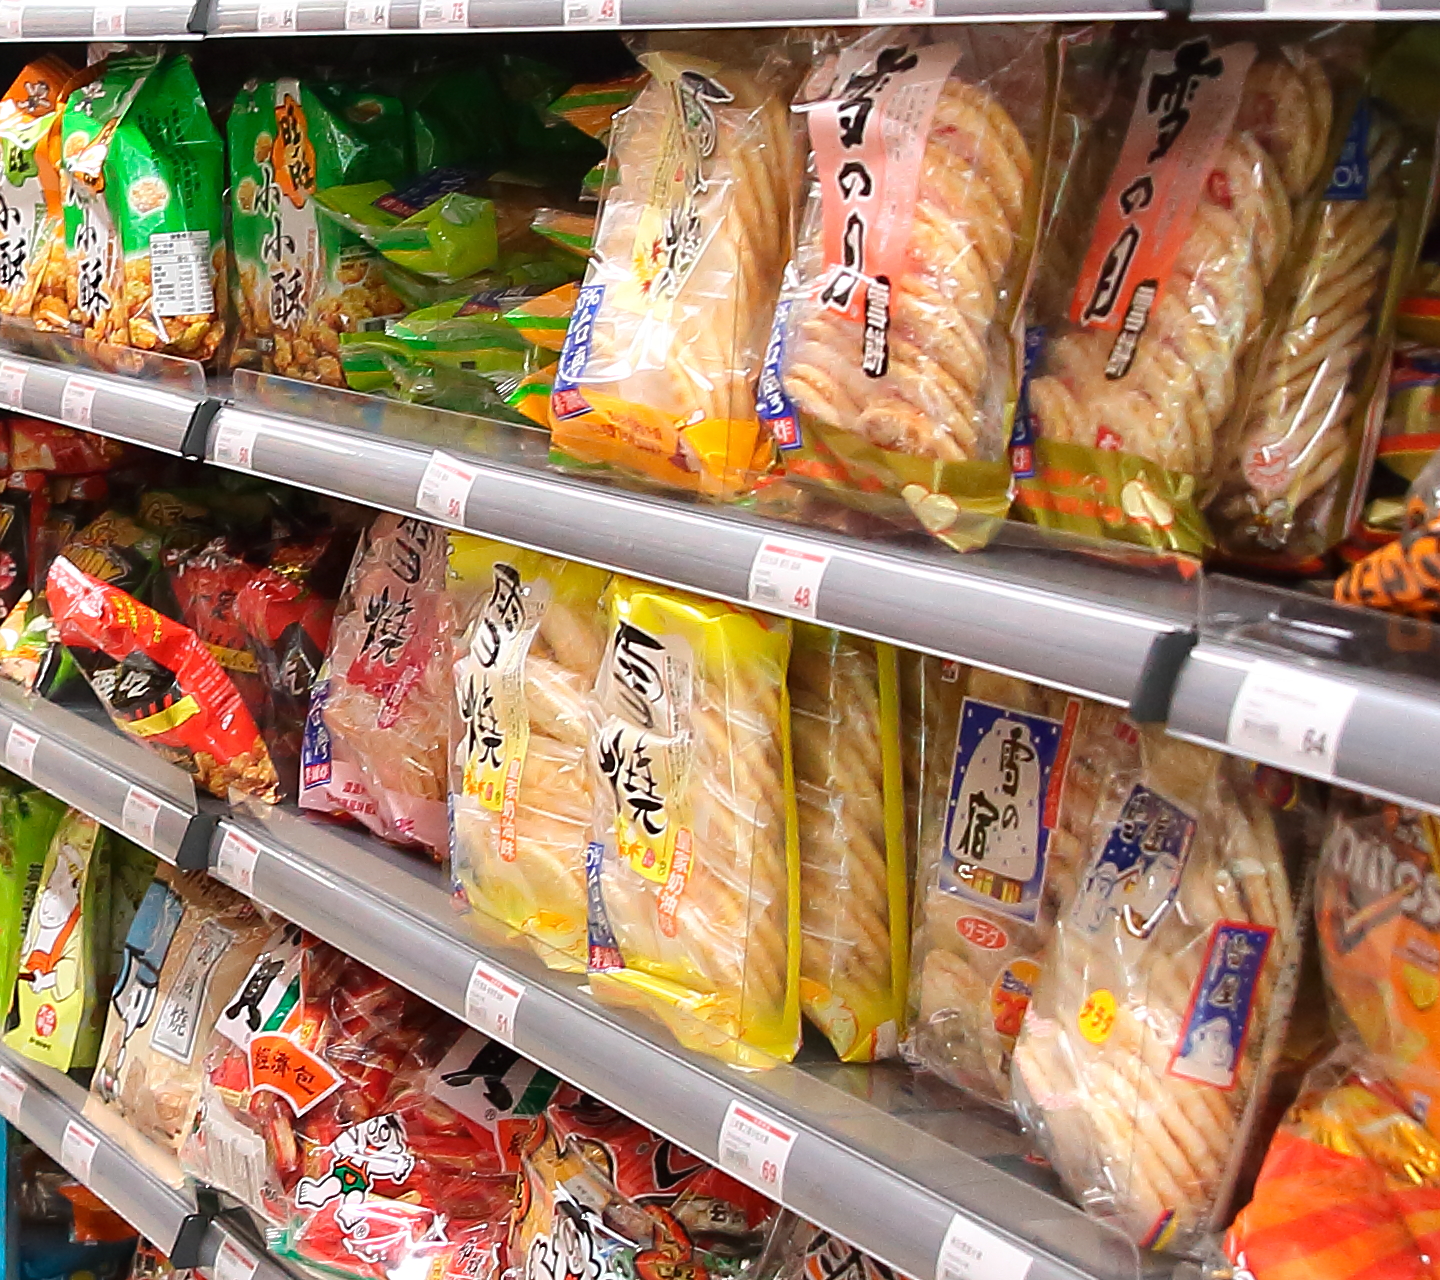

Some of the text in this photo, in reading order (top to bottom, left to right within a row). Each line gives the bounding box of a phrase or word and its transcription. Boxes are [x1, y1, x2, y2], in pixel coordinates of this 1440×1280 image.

[254, 162, 308, 331] 小小酥
[793, 587, 810, 608] 48
[962, 918, 1005, 950] サラダ
[252, 1043, 317, 1098] 經濟包
[761, 1160, 777, 1184] 69
